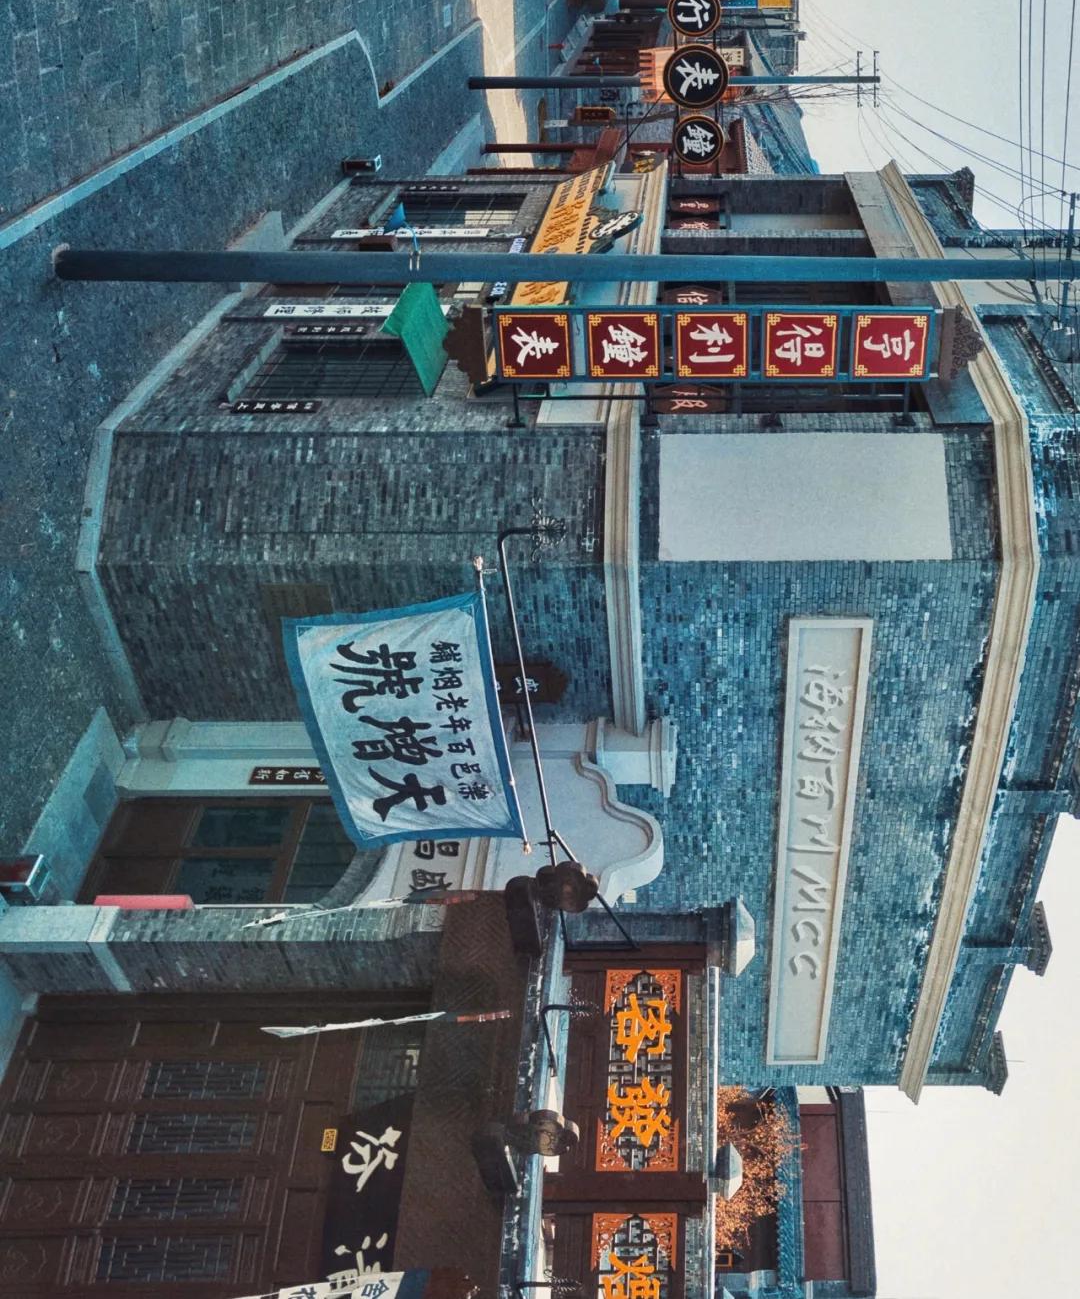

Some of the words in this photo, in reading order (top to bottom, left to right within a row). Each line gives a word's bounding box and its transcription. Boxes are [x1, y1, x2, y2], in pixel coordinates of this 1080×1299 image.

[510, 322, 916, 368] 亨得利鐘表
[329, 640, 447, 822] 天增號
[788, 865, 829, 981] MCC
